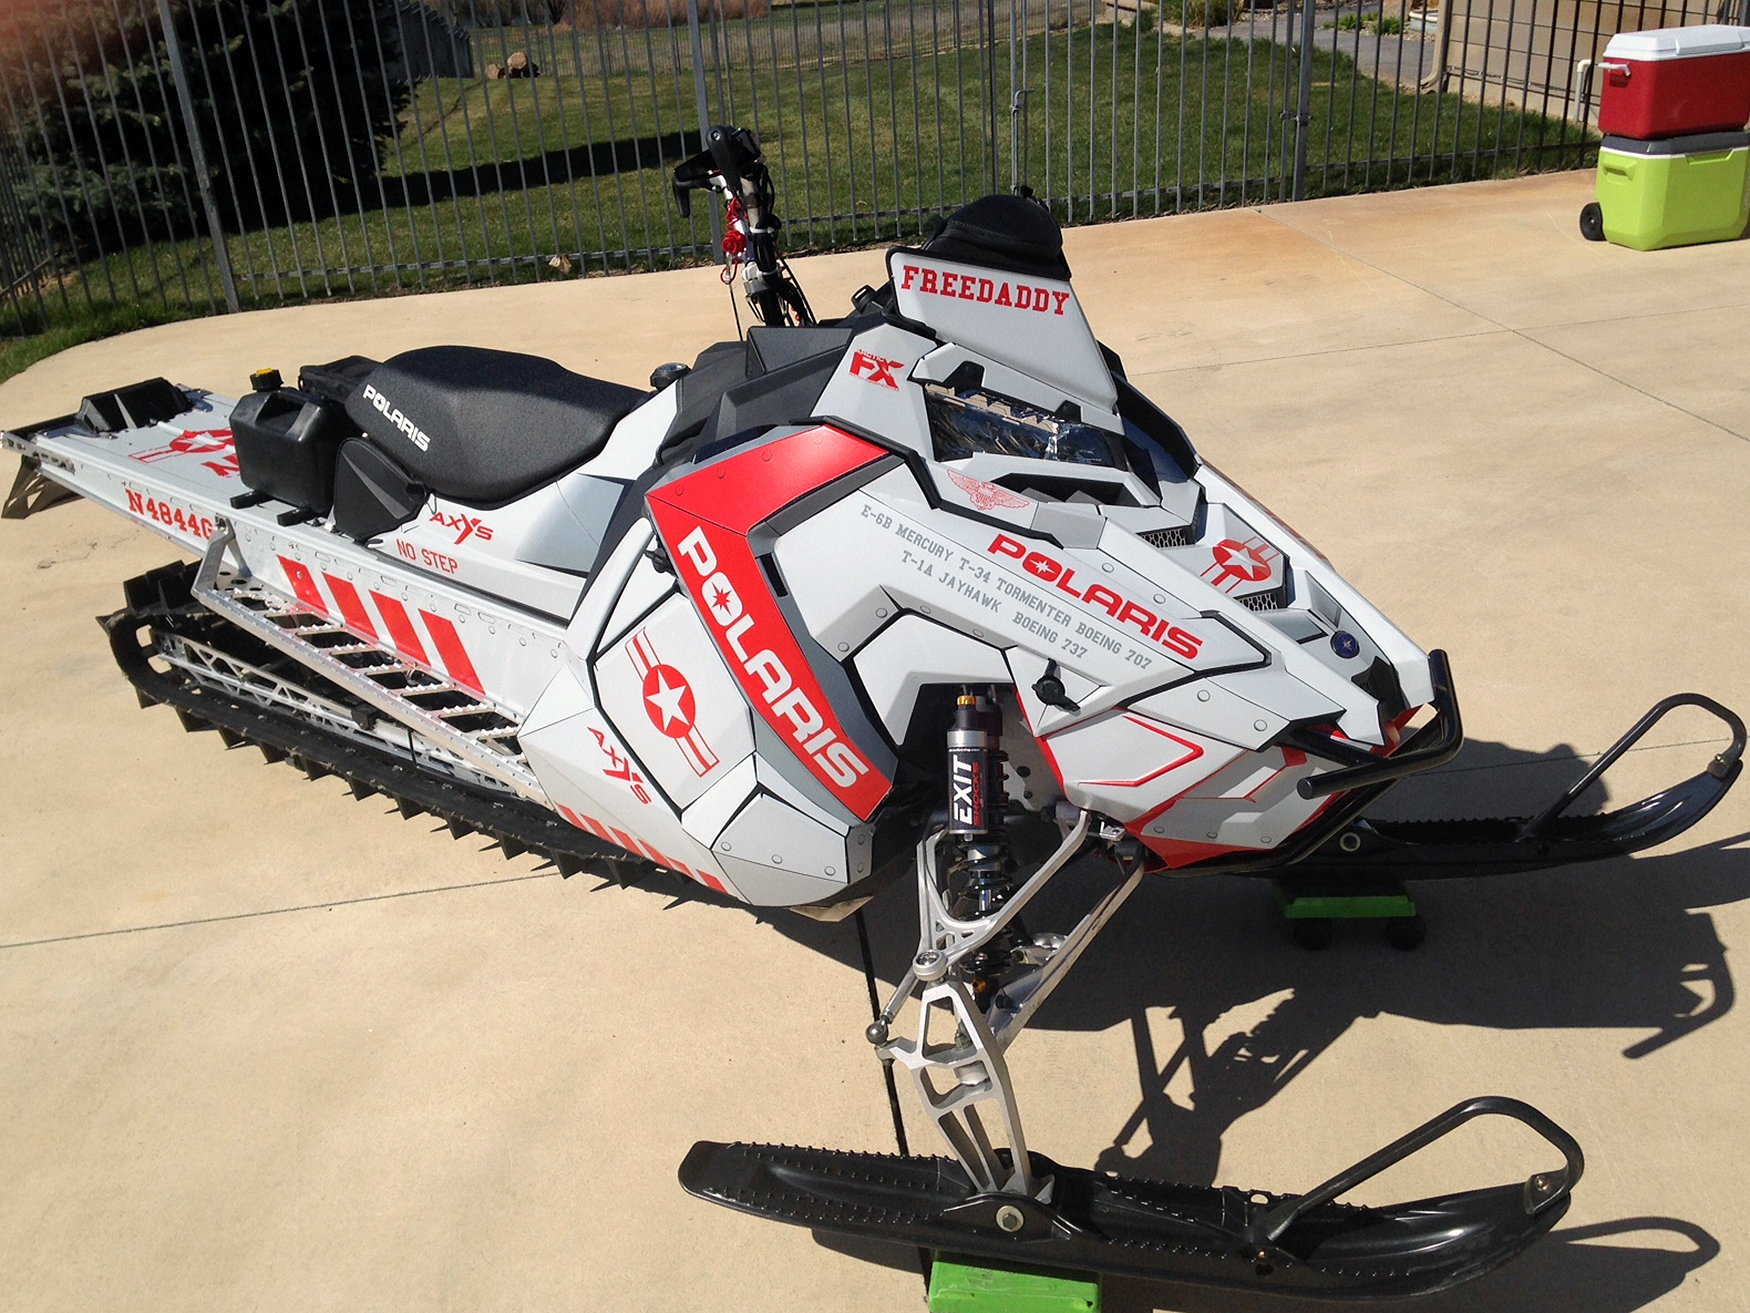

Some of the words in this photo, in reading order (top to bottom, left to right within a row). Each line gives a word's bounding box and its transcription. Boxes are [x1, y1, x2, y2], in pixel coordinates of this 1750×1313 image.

[901, 264, 1069, 316] FREEDADDY
[850, 352, 904, 390] FX
[363, 384, 430, 452] POLARIS
[396, 539, 416, 561] NO
[421, 548, 458, 575] STEP
[429, 512, 493, 545] AXYS
[860, 504, 893, 530] E-6B
[895, 523, 954, 562] MERCURY
[959, 557, 992, 584] T-34
[997, 577, 1072, 627] TORMENTER
[1075, 621, 1122, 655] BOEING
[1125, 649, 1153, 670] 707
[901, 550, 934, 577] T-1A
[938, 572, 1002, 613] JAYHAWK
[1012, 611, 1059, 644] BOEING
[1061, 638, 1089, 659] 737
[987, 533, 1202, 660] POLARIS
[677, 525, 869, 790] POLARIS
[587, 727, 652, 804] AXYS
[953, 754, 973, 825] EXIT
